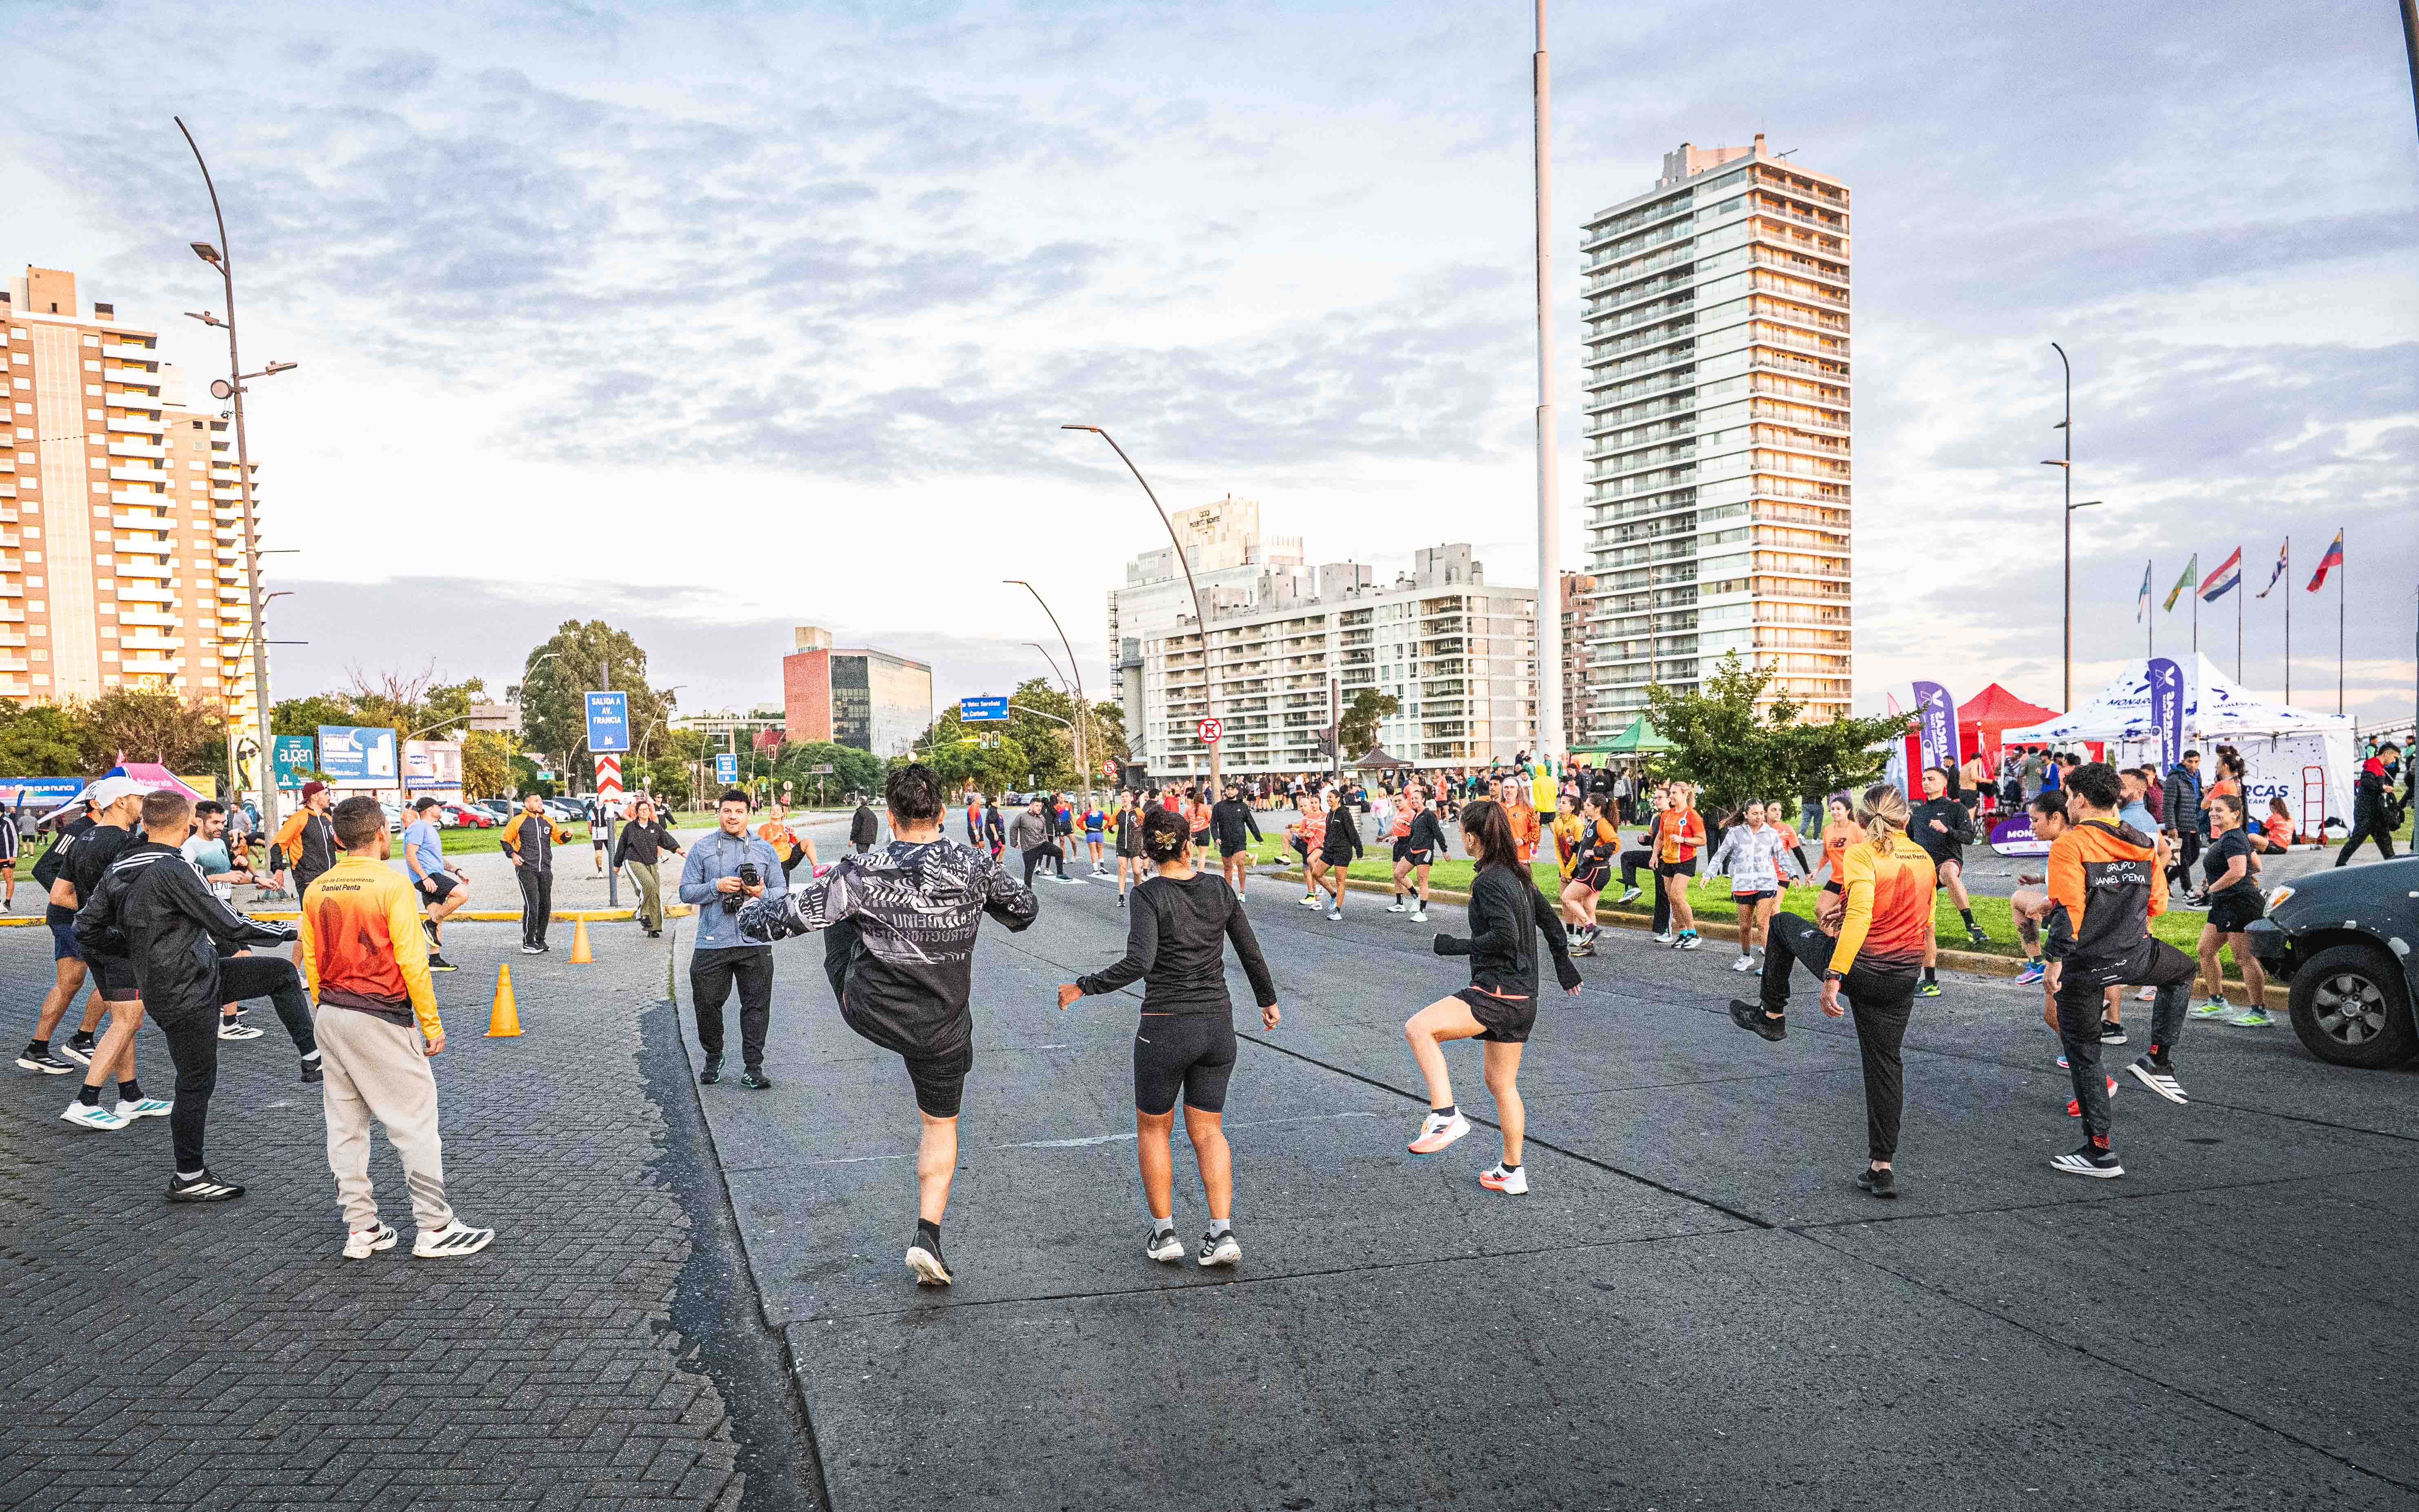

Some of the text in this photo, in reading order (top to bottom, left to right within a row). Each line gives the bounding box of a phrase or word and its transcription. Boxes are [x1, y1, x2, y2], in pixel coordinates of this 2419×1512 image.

[593, 716, 622, 724] FRANCIA
[2246, 785, 2289, 797] RCAS
[2106, 861, 2136, 873] GRUPO
